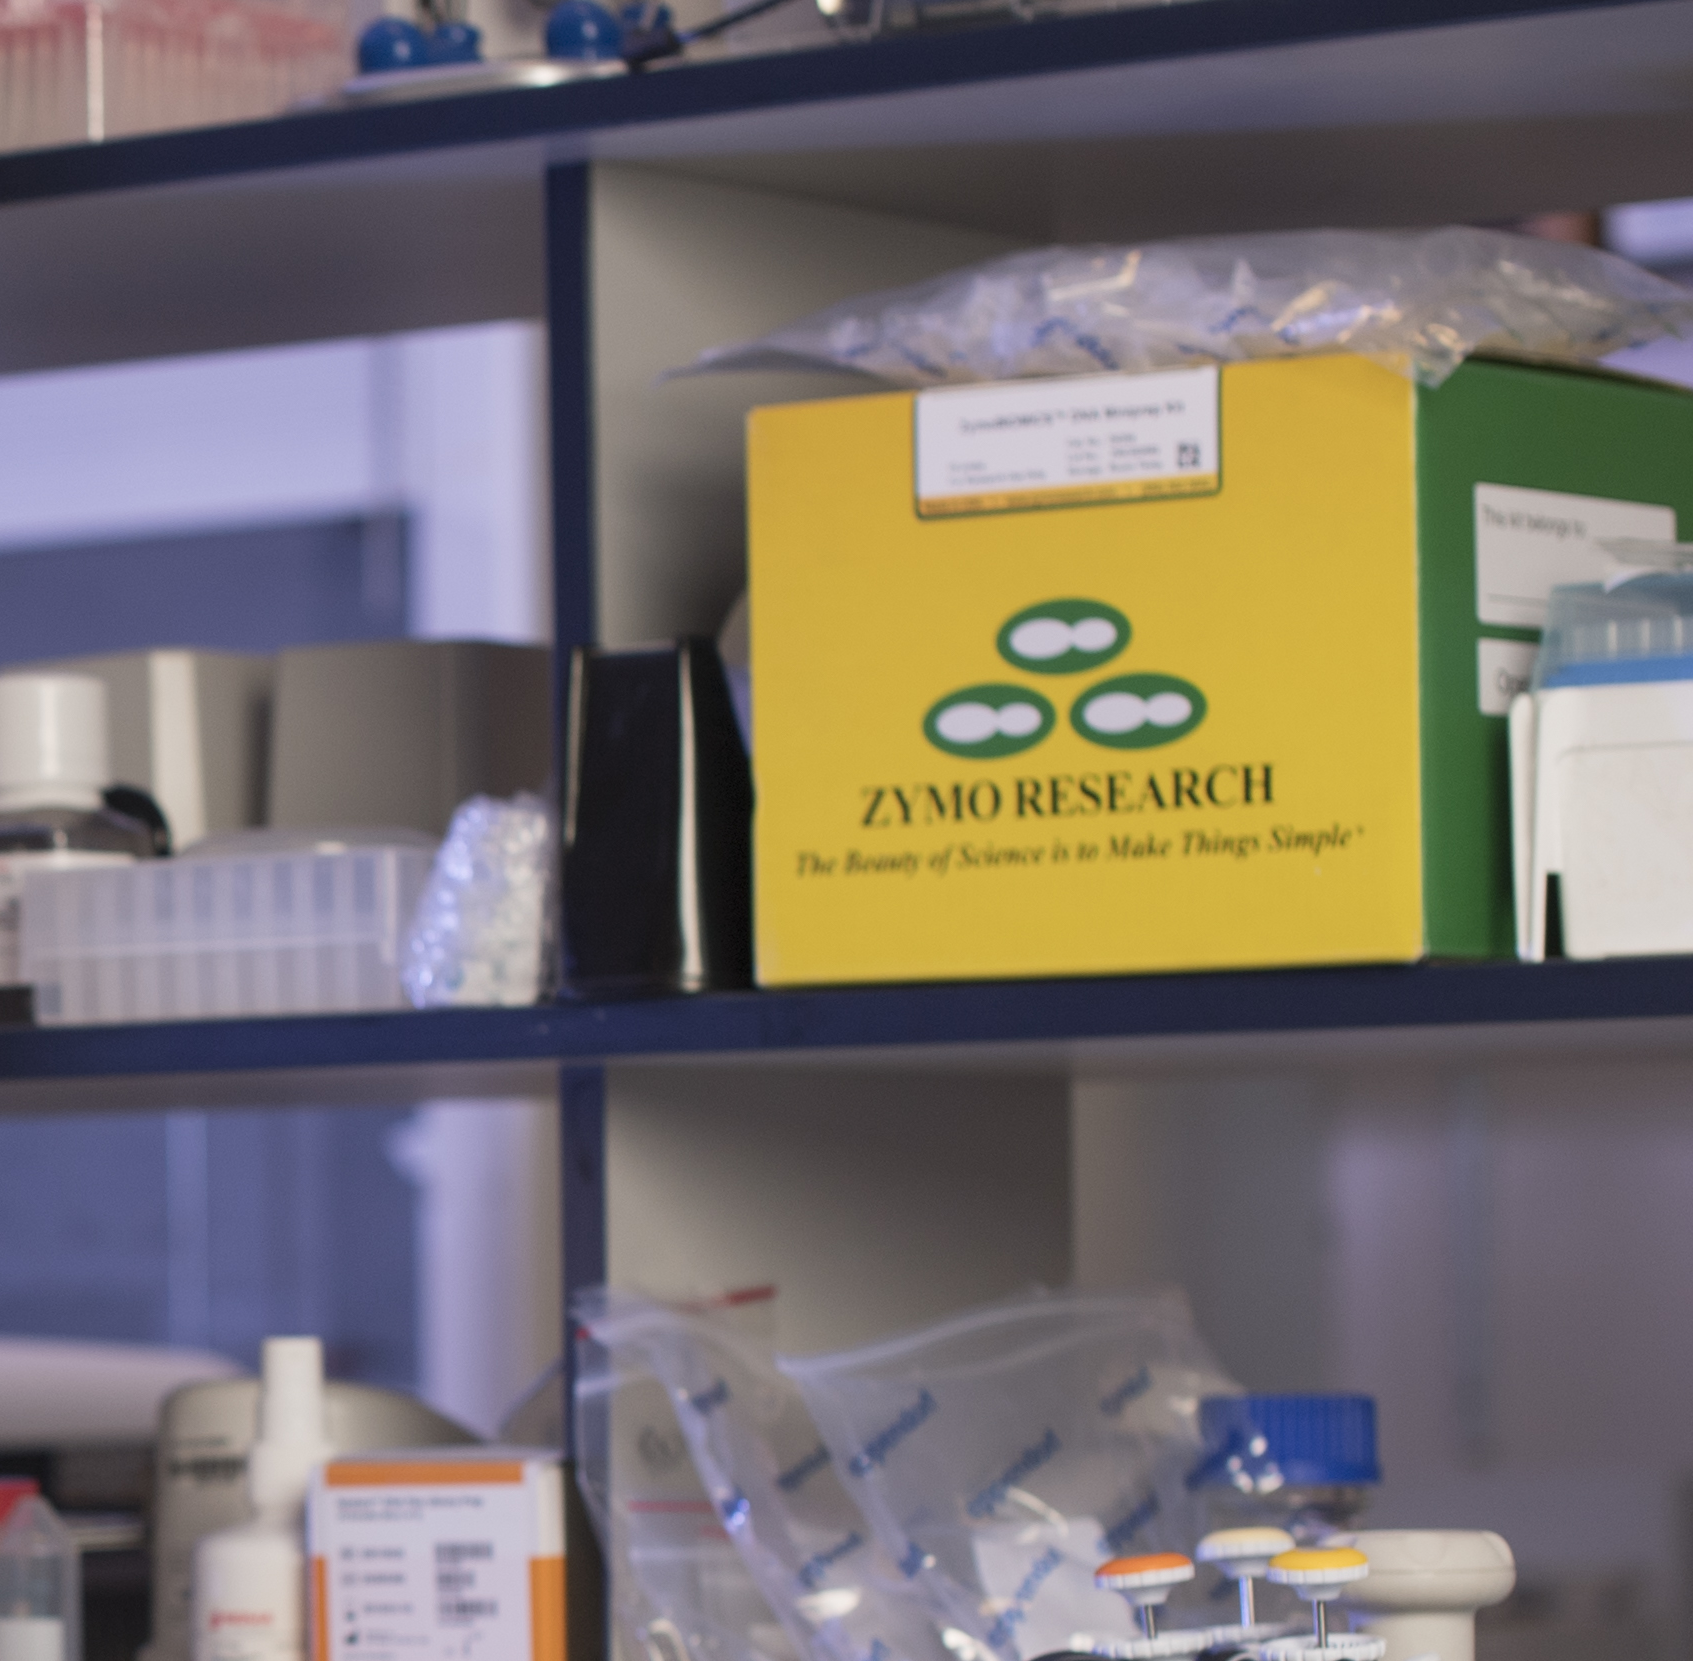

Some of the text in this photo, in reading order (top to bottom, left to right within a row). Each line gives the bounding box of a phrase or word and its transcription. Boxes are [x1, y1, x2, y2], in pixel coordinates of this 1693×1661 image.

[860, 763, 1274, 828] ZYMO RESEARCH
[796, 850, 839, 881] The
[844, 848, 920, 880] Beauty
[928, 842, 957, 880] of
[958, 837, 1046, 873] Science
[1050, 836, 1070, 864] is
[1076, 838, 1100, 862] to
[1107, 830, 1173, 860] Make
[1181, 827, 1260, 864] Things
